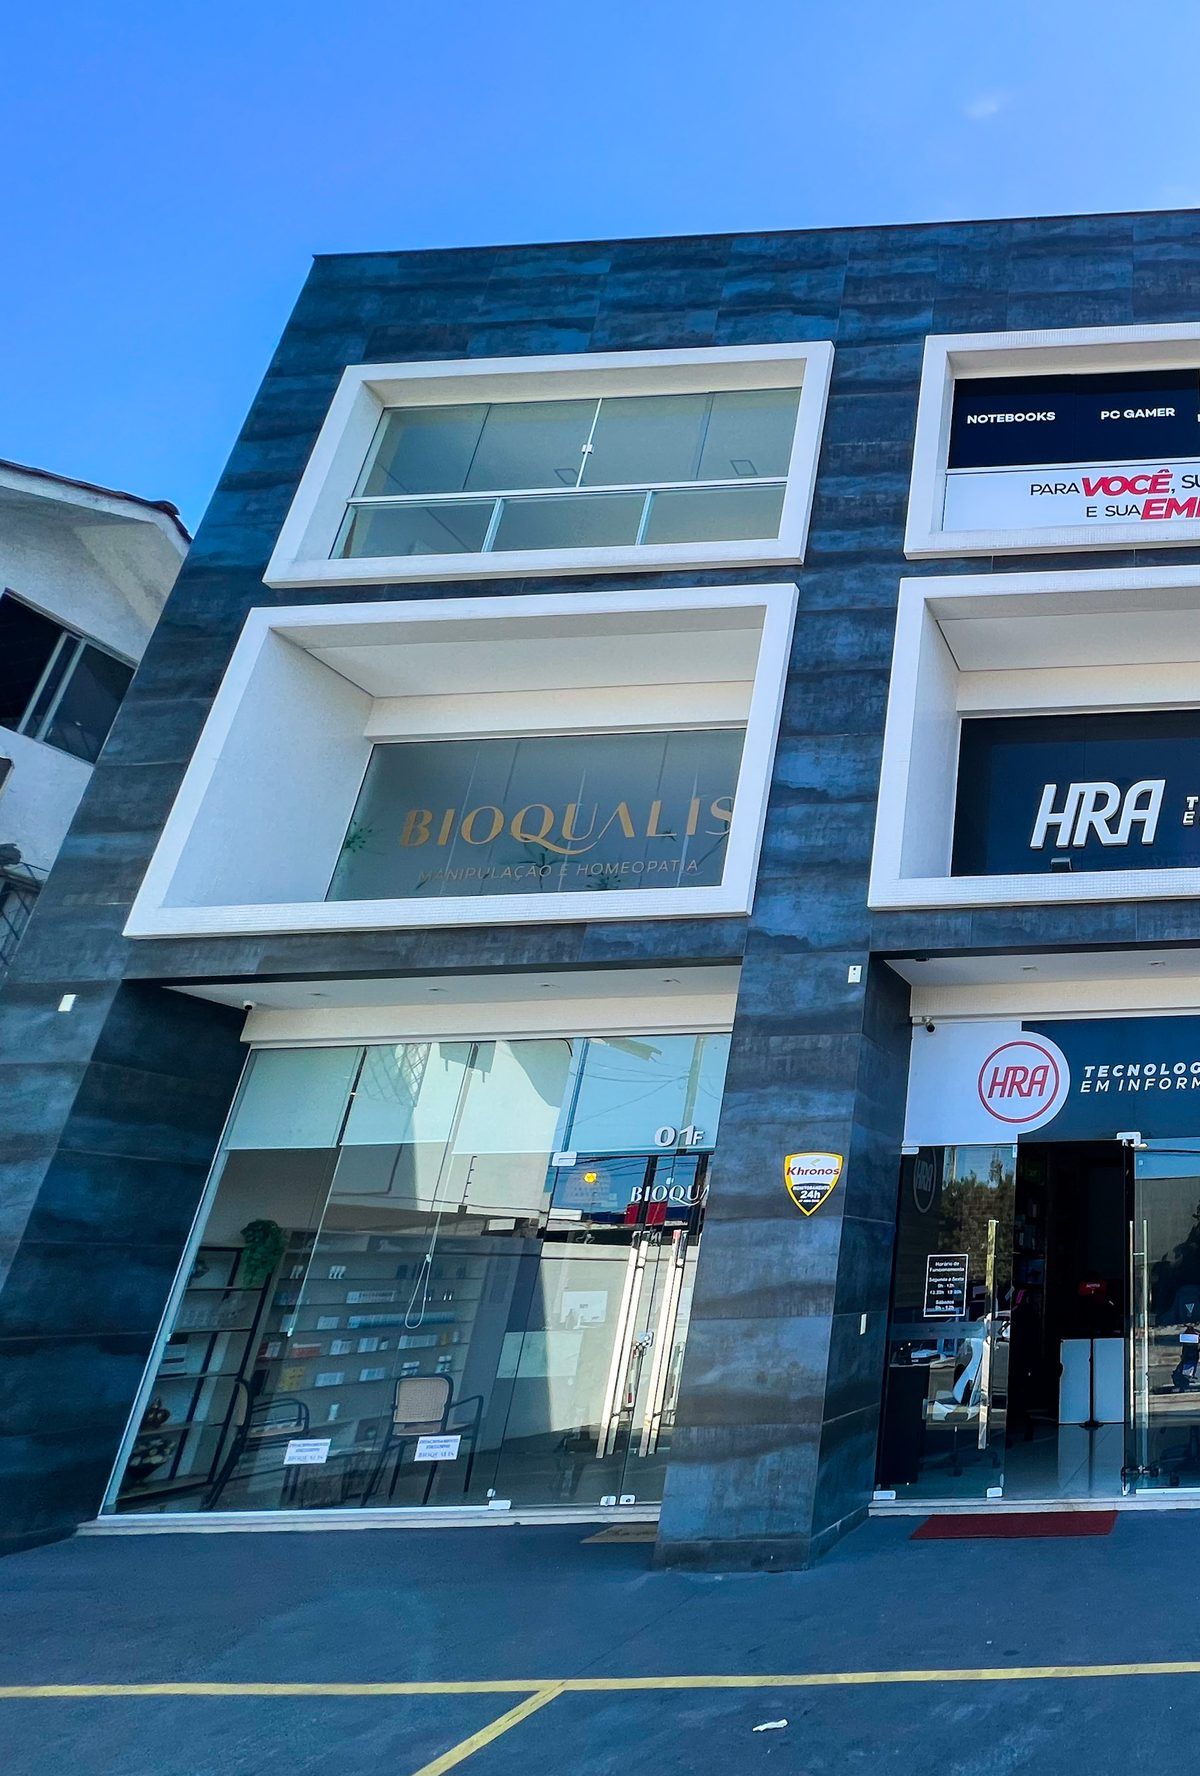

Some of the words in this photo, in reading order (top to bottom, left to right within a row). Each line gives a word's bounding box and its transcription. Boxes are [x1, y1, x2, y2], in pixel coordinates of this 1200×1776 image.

[967, 411, 1056, 425] NOTEBOOKS
[1100, 410, 1120, 421] PC
[1123, 407, 1175, 419] GAMER
[1030, 482, 1080, 496] PARA
[1086, 506, 1098, 518] E
[1105, 504, 1141, 517] SUA
[1029, 778, 1167, 850] HRA
[400, 795, 734, 857] BIOQUALIS
[419, 864, 552, 882] MANIPULAÇÃO
[559, 865, 569, 877] E
[576, 859, 699, 876] HOMEOPATIA
[987, 1064, 1050, 1099] HRA
[1080, 1079, 1111, 1094] EM
[787, 1166, 840, 1176] Khronos
[800, 1190, 821, 1199] 24h
